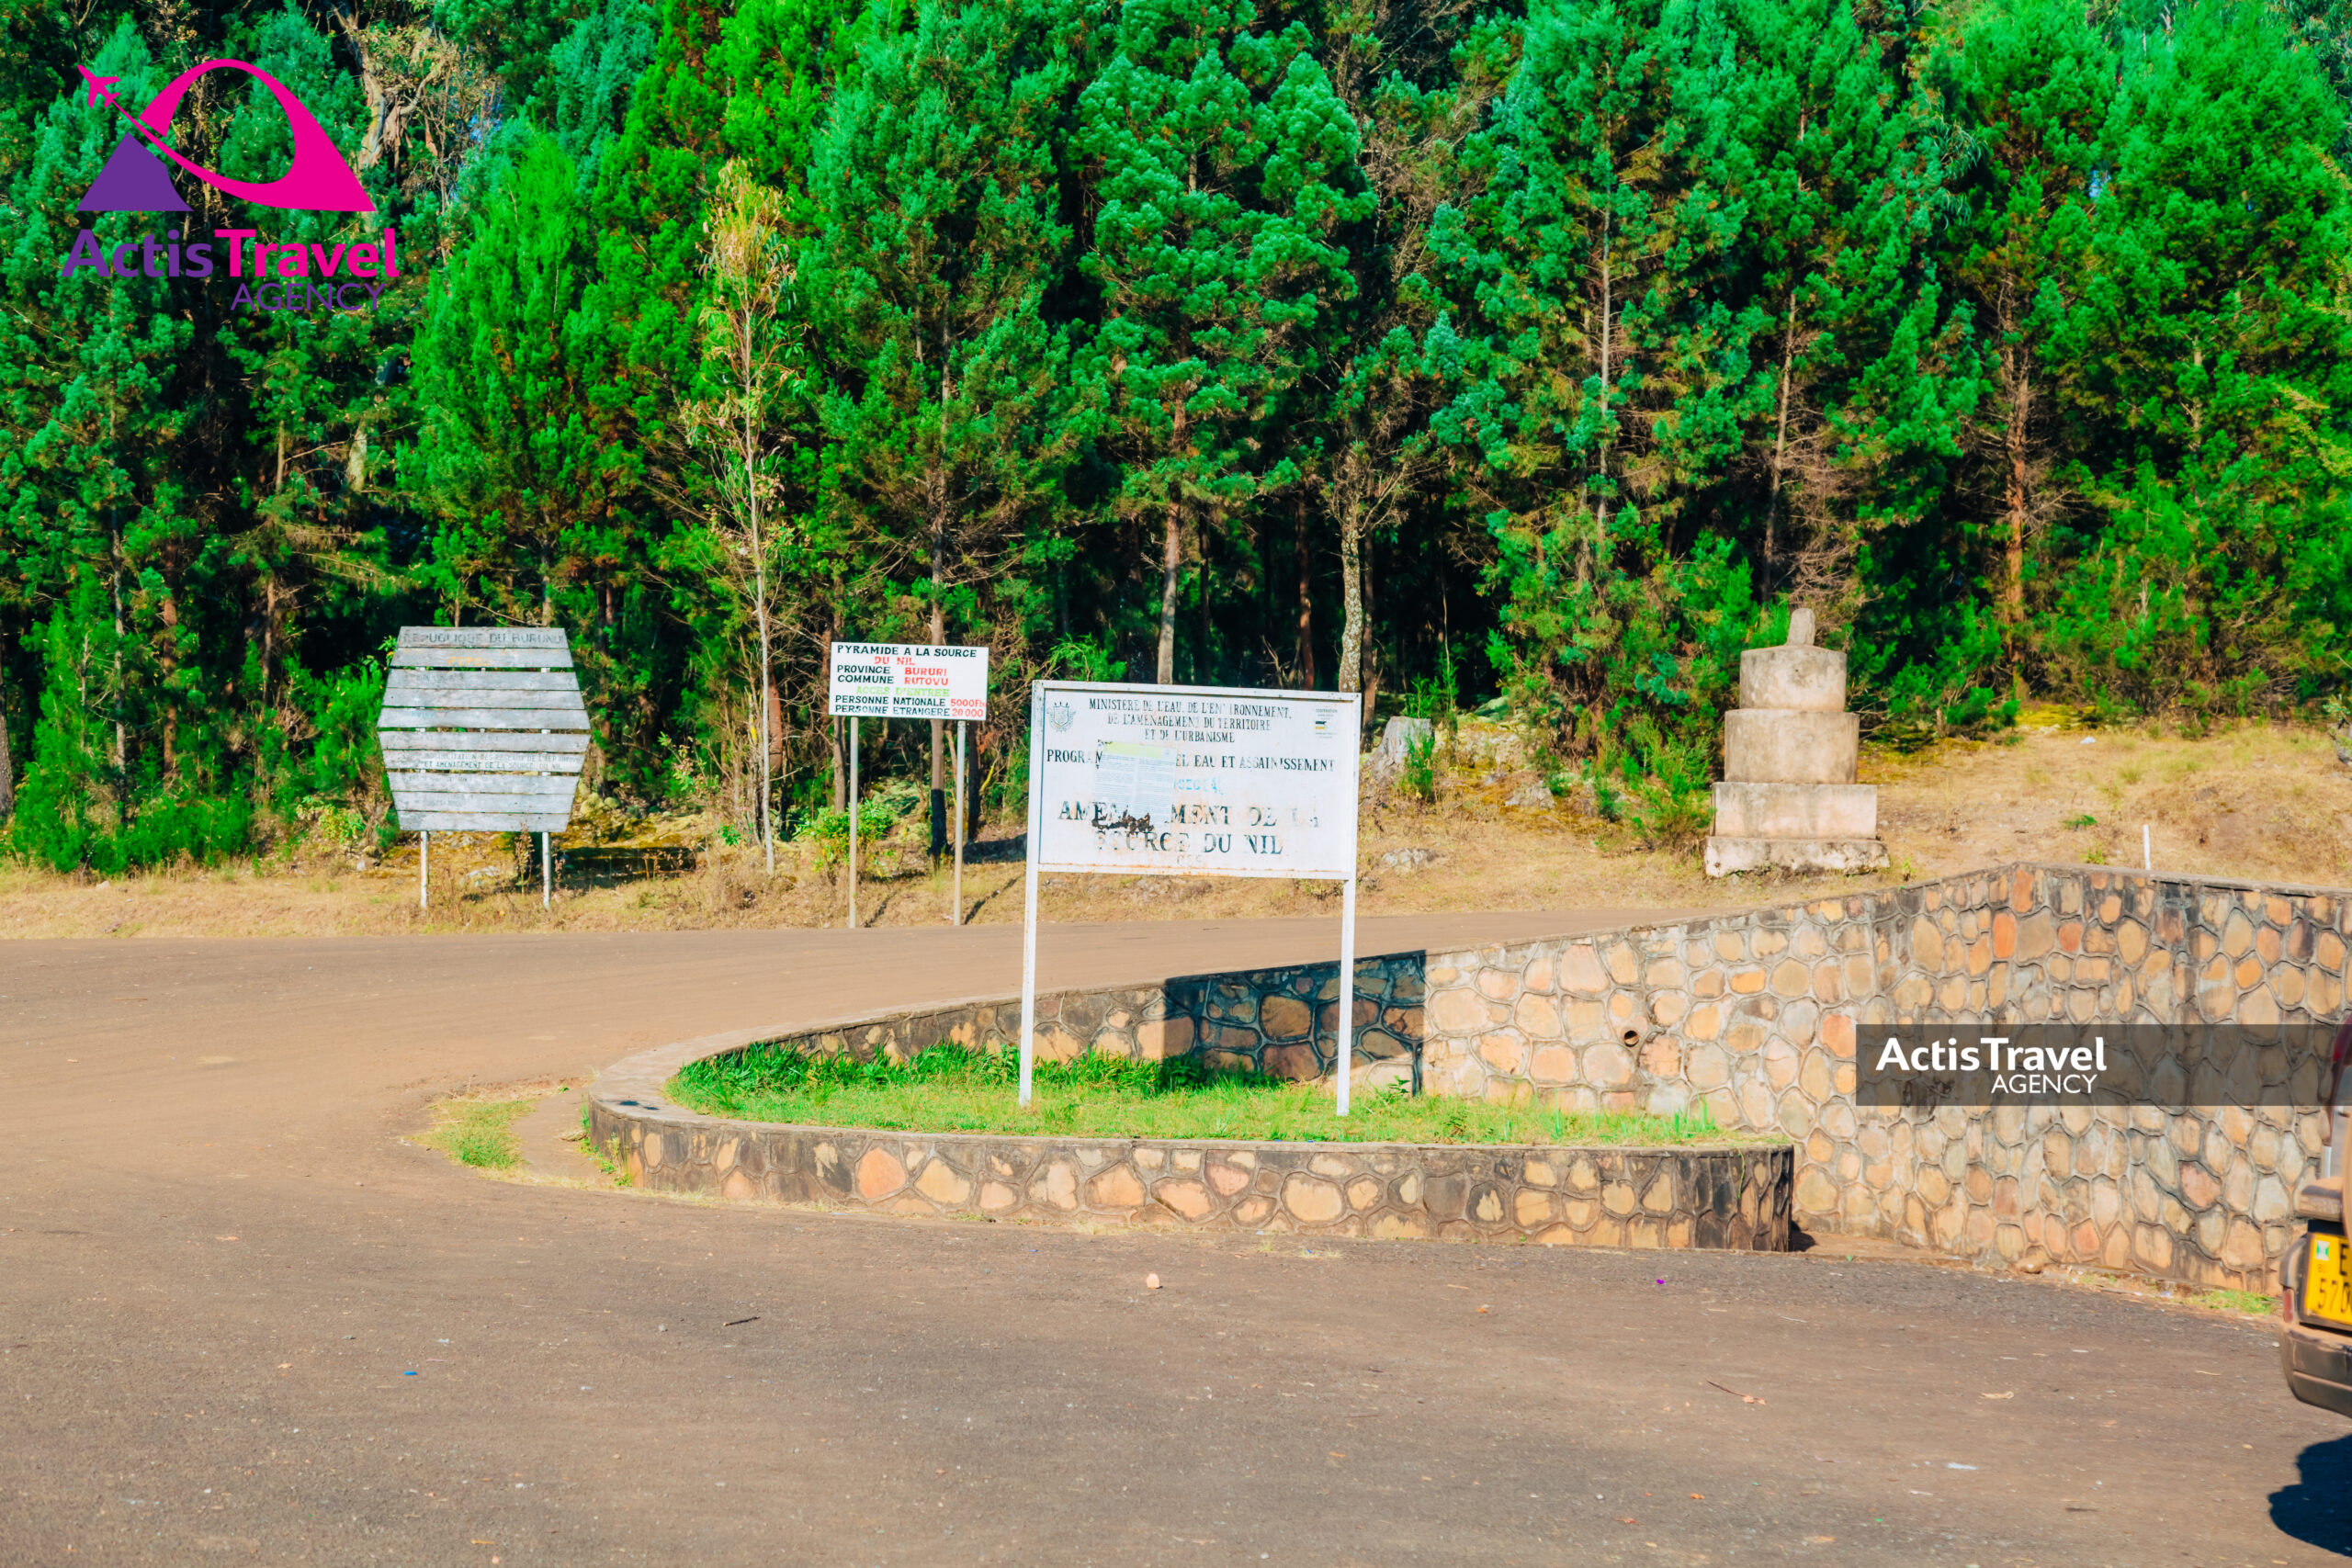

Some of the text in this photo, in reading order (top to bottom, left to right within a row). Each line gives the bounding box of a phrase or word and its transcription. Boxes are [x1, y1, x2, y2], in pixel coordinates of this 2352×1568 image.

[837, 645, 977, 658] PYRAMIDE A LA SOURCE
[875, 656, 916, 666] DU NIL
[837, 664, 947, 676] PROVINCE BURURI
[837, 674, 948, 686] COMMUNE RUTOVU
[856, 686, 890, 695] ACCES
[835, 694, 889, 705] PERSONNE
[893, 696, 946, 706] NATIONALE
[1089, 698, 1139, 711] MINISTERE
[1143, 700, 1153, 711] DE
[1188, 702, 1198, 714] DE
[835, 705, 889, 715] PERSONNE
[893, 706, 951, 716] ETRANGERE
[1204, 716, 1214, 728] DU
[1218, 718, 1272, 731] TERRITOIRE
[1145, 729, 1155, 740] ET
[1175, 729, 1235, 742] L'URBANISME
[1194, 754, 1216, 767] EAU
[1222, 755, 1236, 768] ET
[1204, 832, 1232, 852] DU
[1243, 834, 1283, 855] NIL
